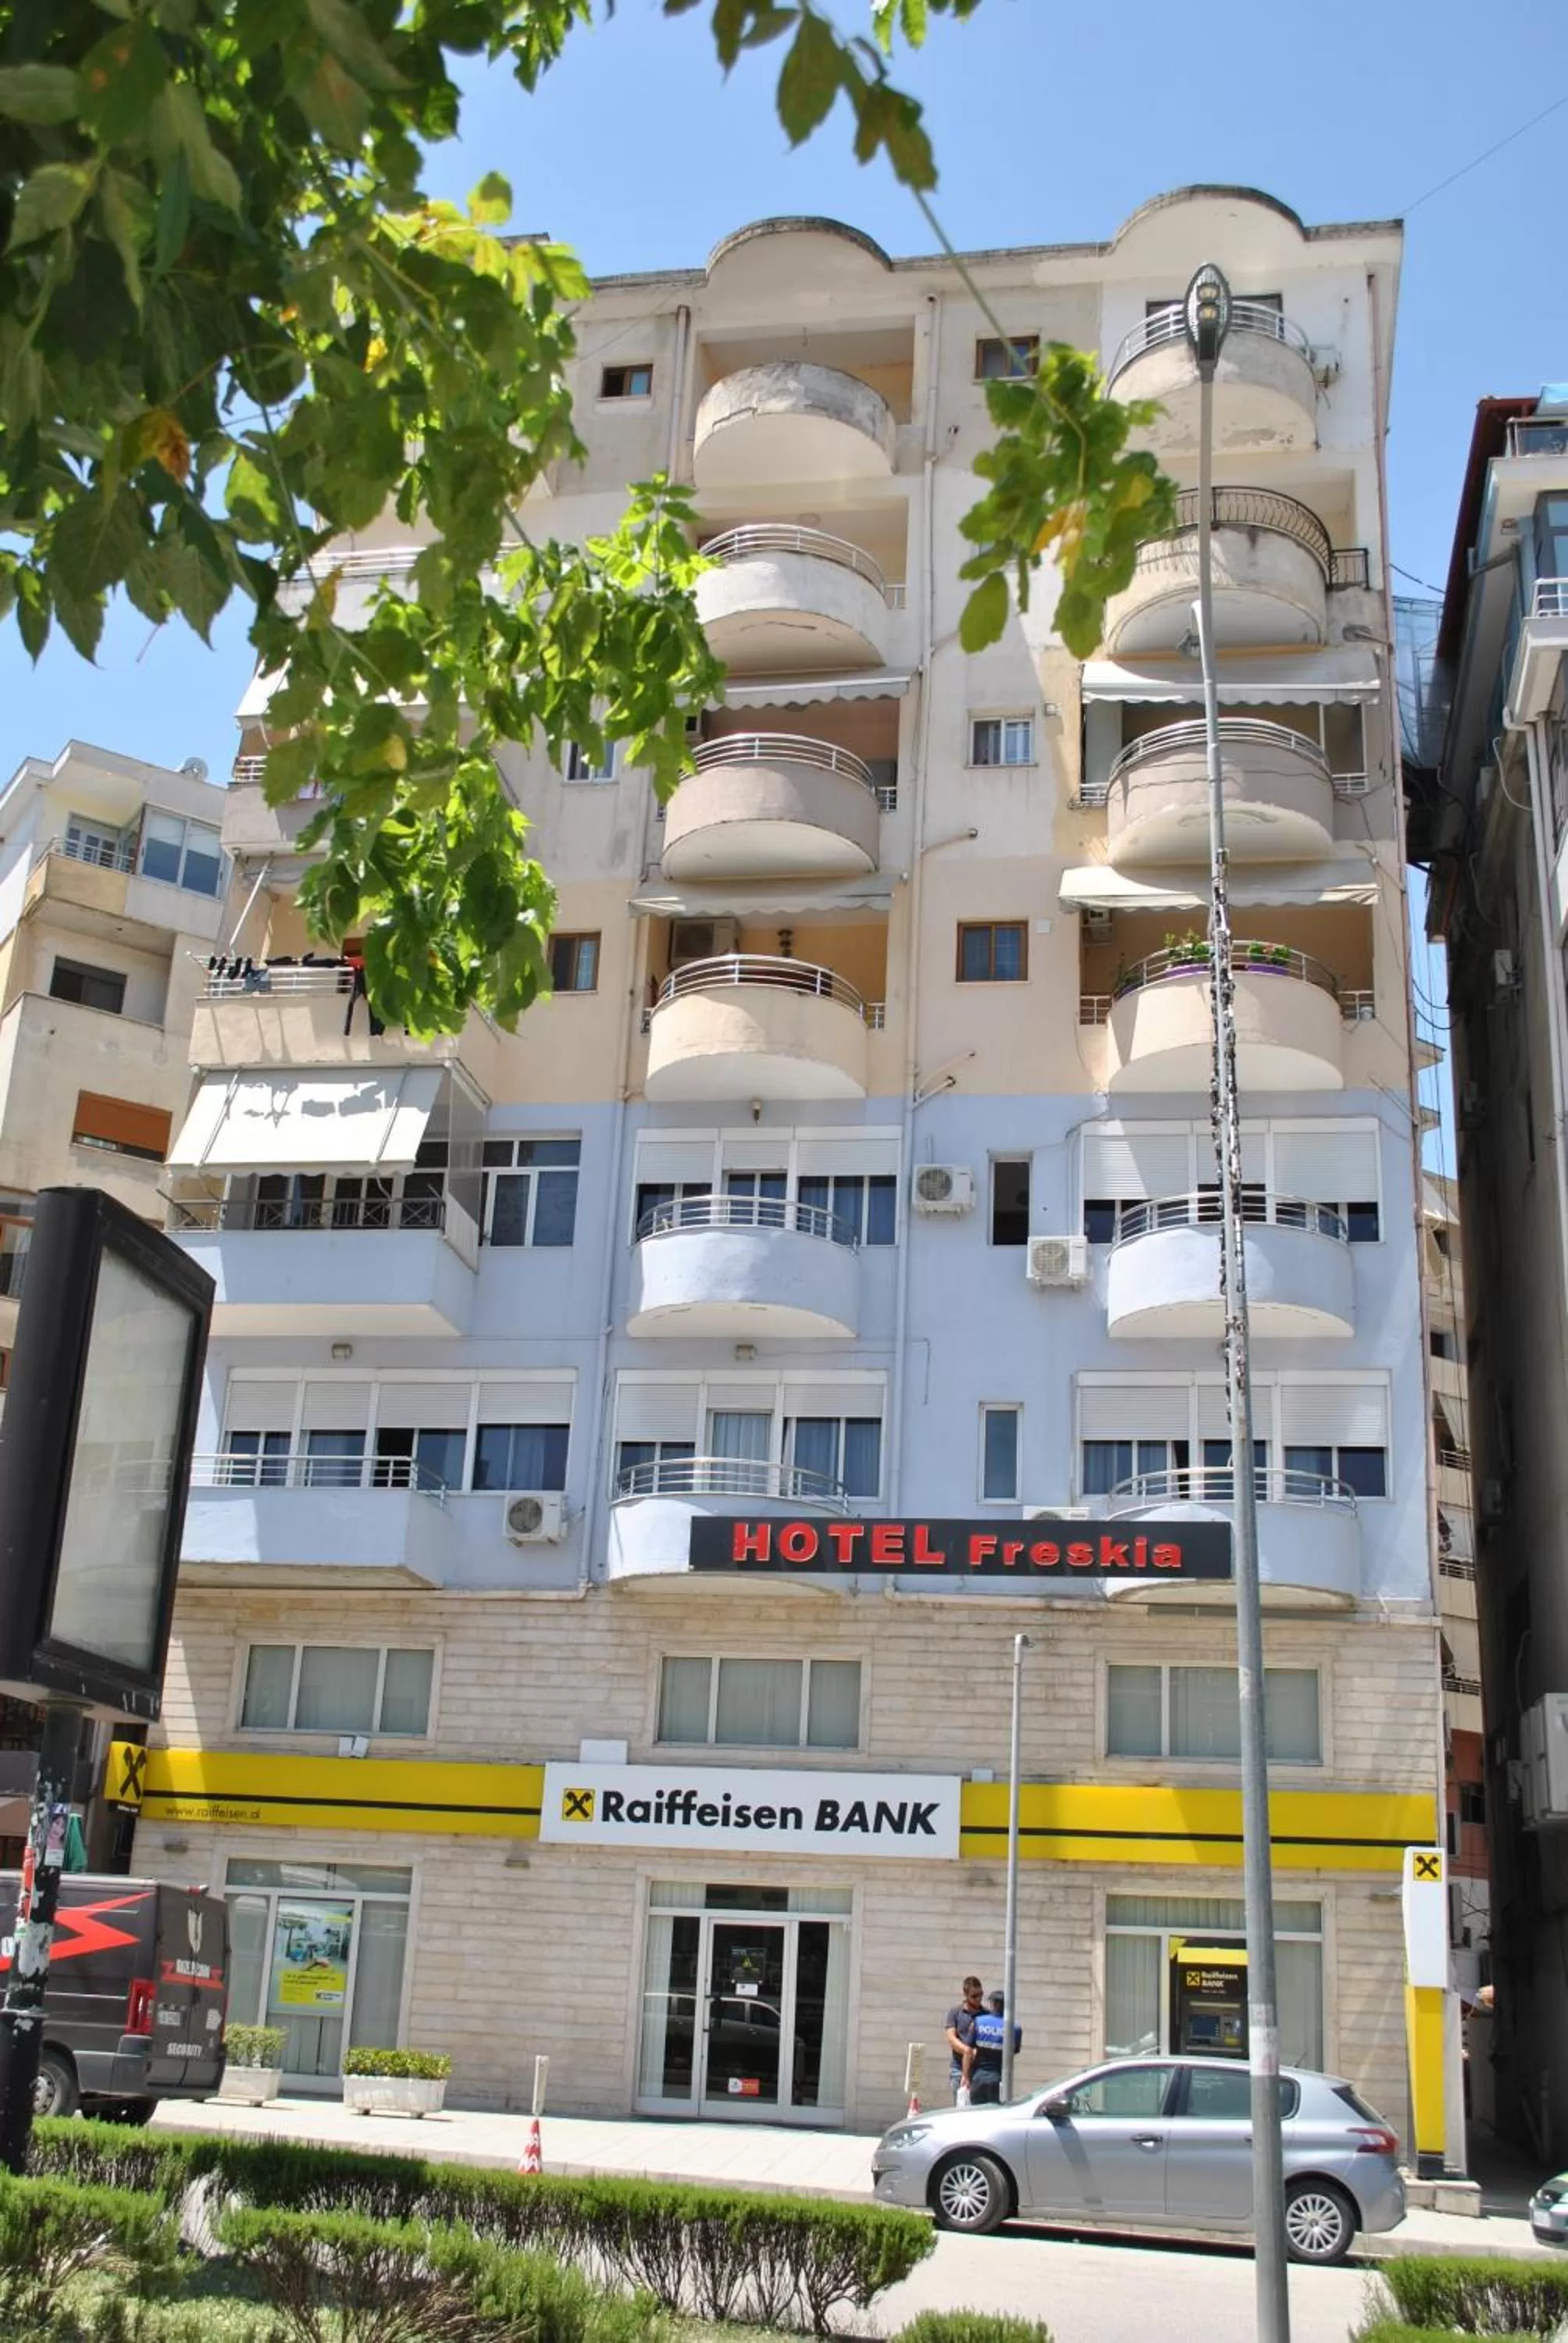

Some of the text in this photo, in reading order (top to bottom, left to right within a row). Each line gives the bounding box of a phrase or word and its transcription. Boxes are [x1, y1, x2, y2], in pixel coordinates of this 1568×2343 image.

[733, 1522, 1183, 1568] HOTEL Freskia
[601, 1789, 940, 1835] Raiffeisen BANK
